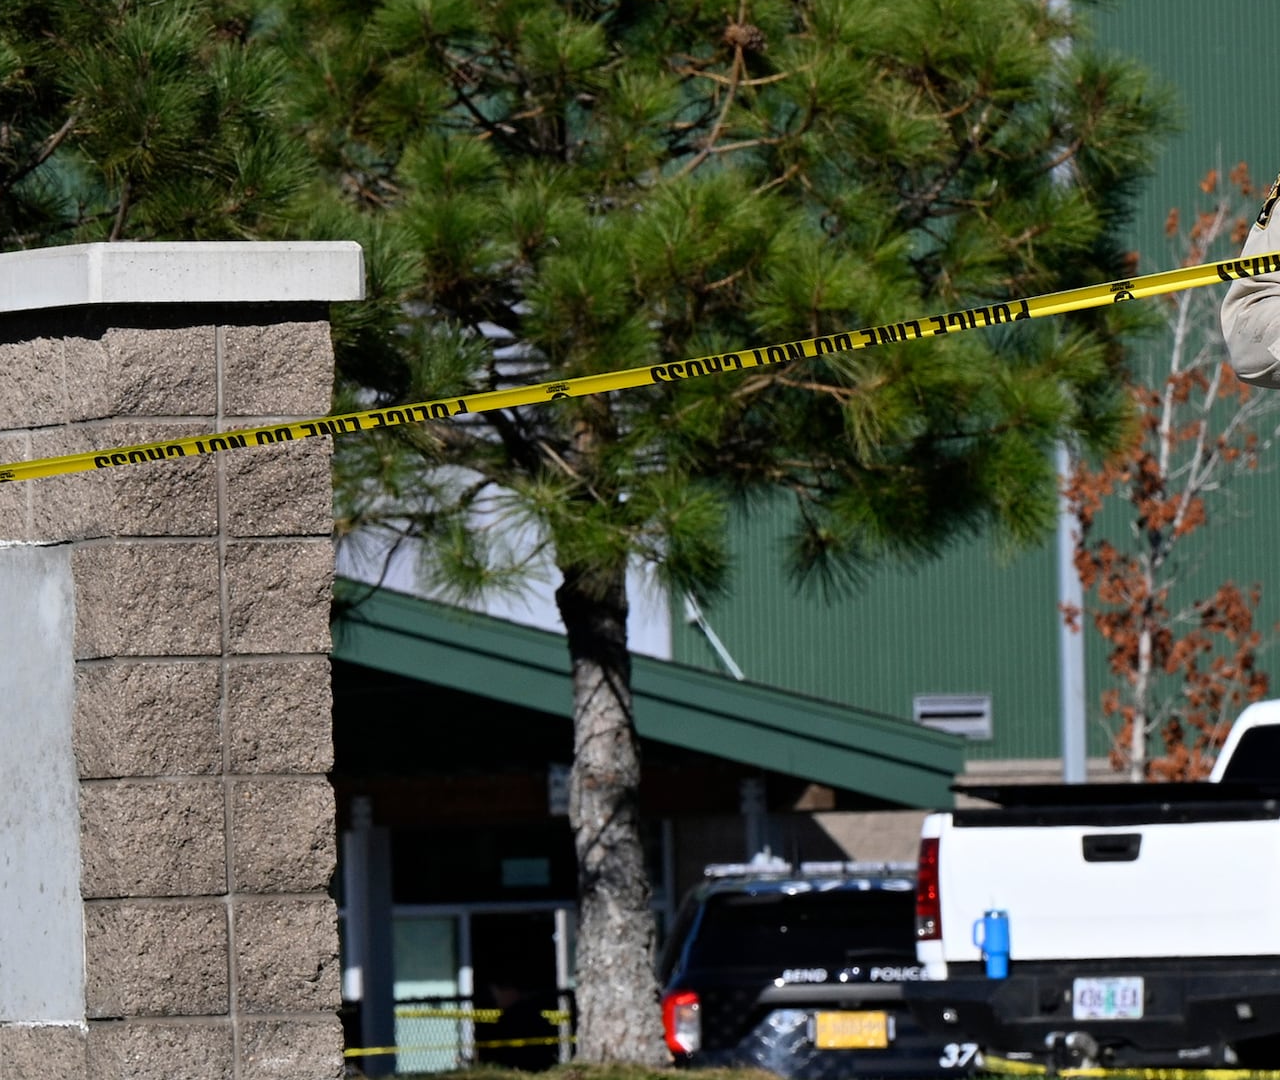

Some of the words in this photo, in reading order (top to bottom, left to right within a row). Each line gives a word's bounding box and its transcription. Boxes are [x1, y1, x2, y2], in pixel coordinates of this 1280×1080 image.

[928, 299, 1030, 335] POLICE
[813, 333, 852, 355] DO
[859, 319, 921, 347] LINE
[753, 341, 804, 366] NOT
[648, 351, 742, 384] CROSS
[782, 968, 828, 983] BEND
[870, 966, 929, 982] POLICE
